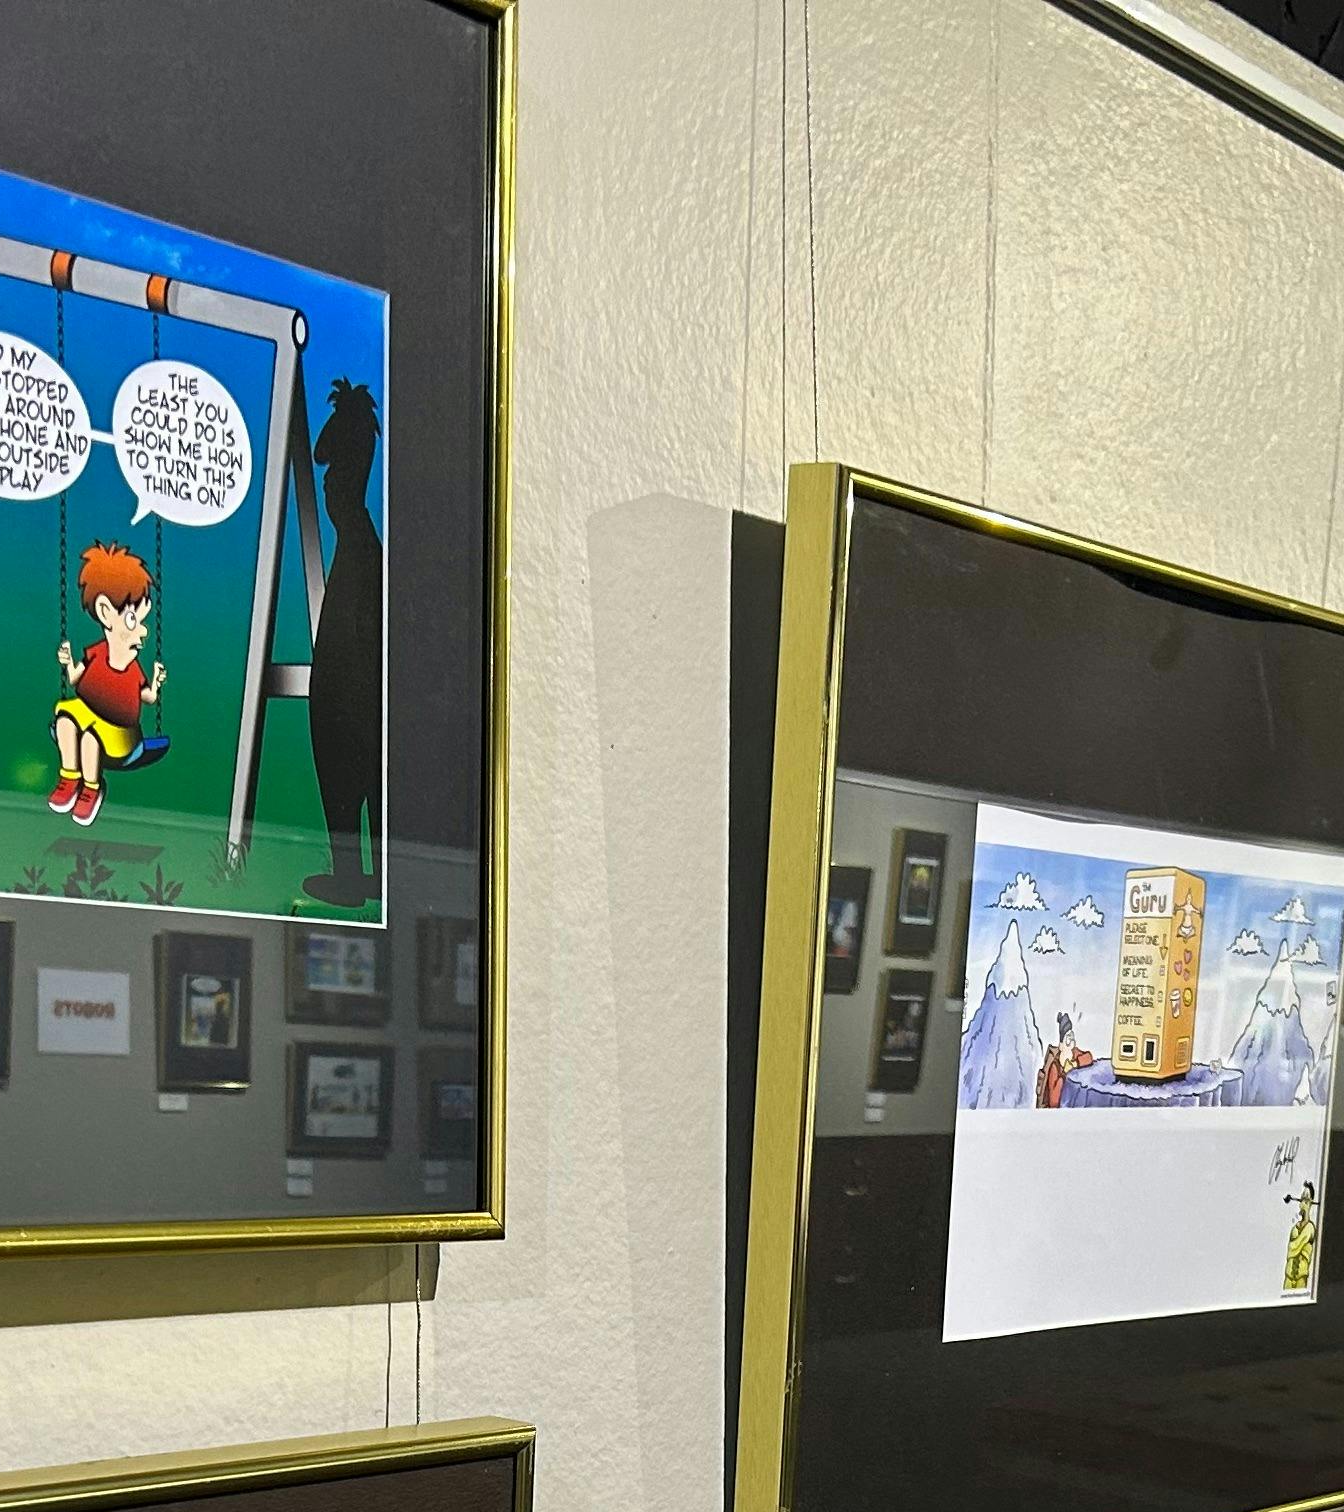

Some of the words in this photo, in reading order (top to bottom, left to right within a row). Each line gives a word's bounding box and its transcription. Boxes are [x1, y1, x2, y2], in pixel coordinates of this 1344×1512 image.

[10, 347, 37, 370] MY
[168, 373, 199, 396] THE
[5, 394, 75, 429] AROUND
[137, 385, 189, 415] LEAST
[195, 400, 229, 425] YOU
[55, 430, 88, 456] AND
[131, 406, 188, 436] COULD
[195, 421, 217, 443] DO
[222, 428, 236, 448] IS
[124, 426, 172, 454] SHOW
[178, 438, 202, 461] ME
[208, 446, 243, 472] HOW
[0, 466, 43, 493] PLAY
[127, 449, 149, 469] TO
[155, 456, 197, 481] TURN
[203, 467, 236, 489] THIS
[143, 475, 191, 501] THING
[197, 487, 227, 508] ON!
[1129, 885, 1167, 914] Guru
